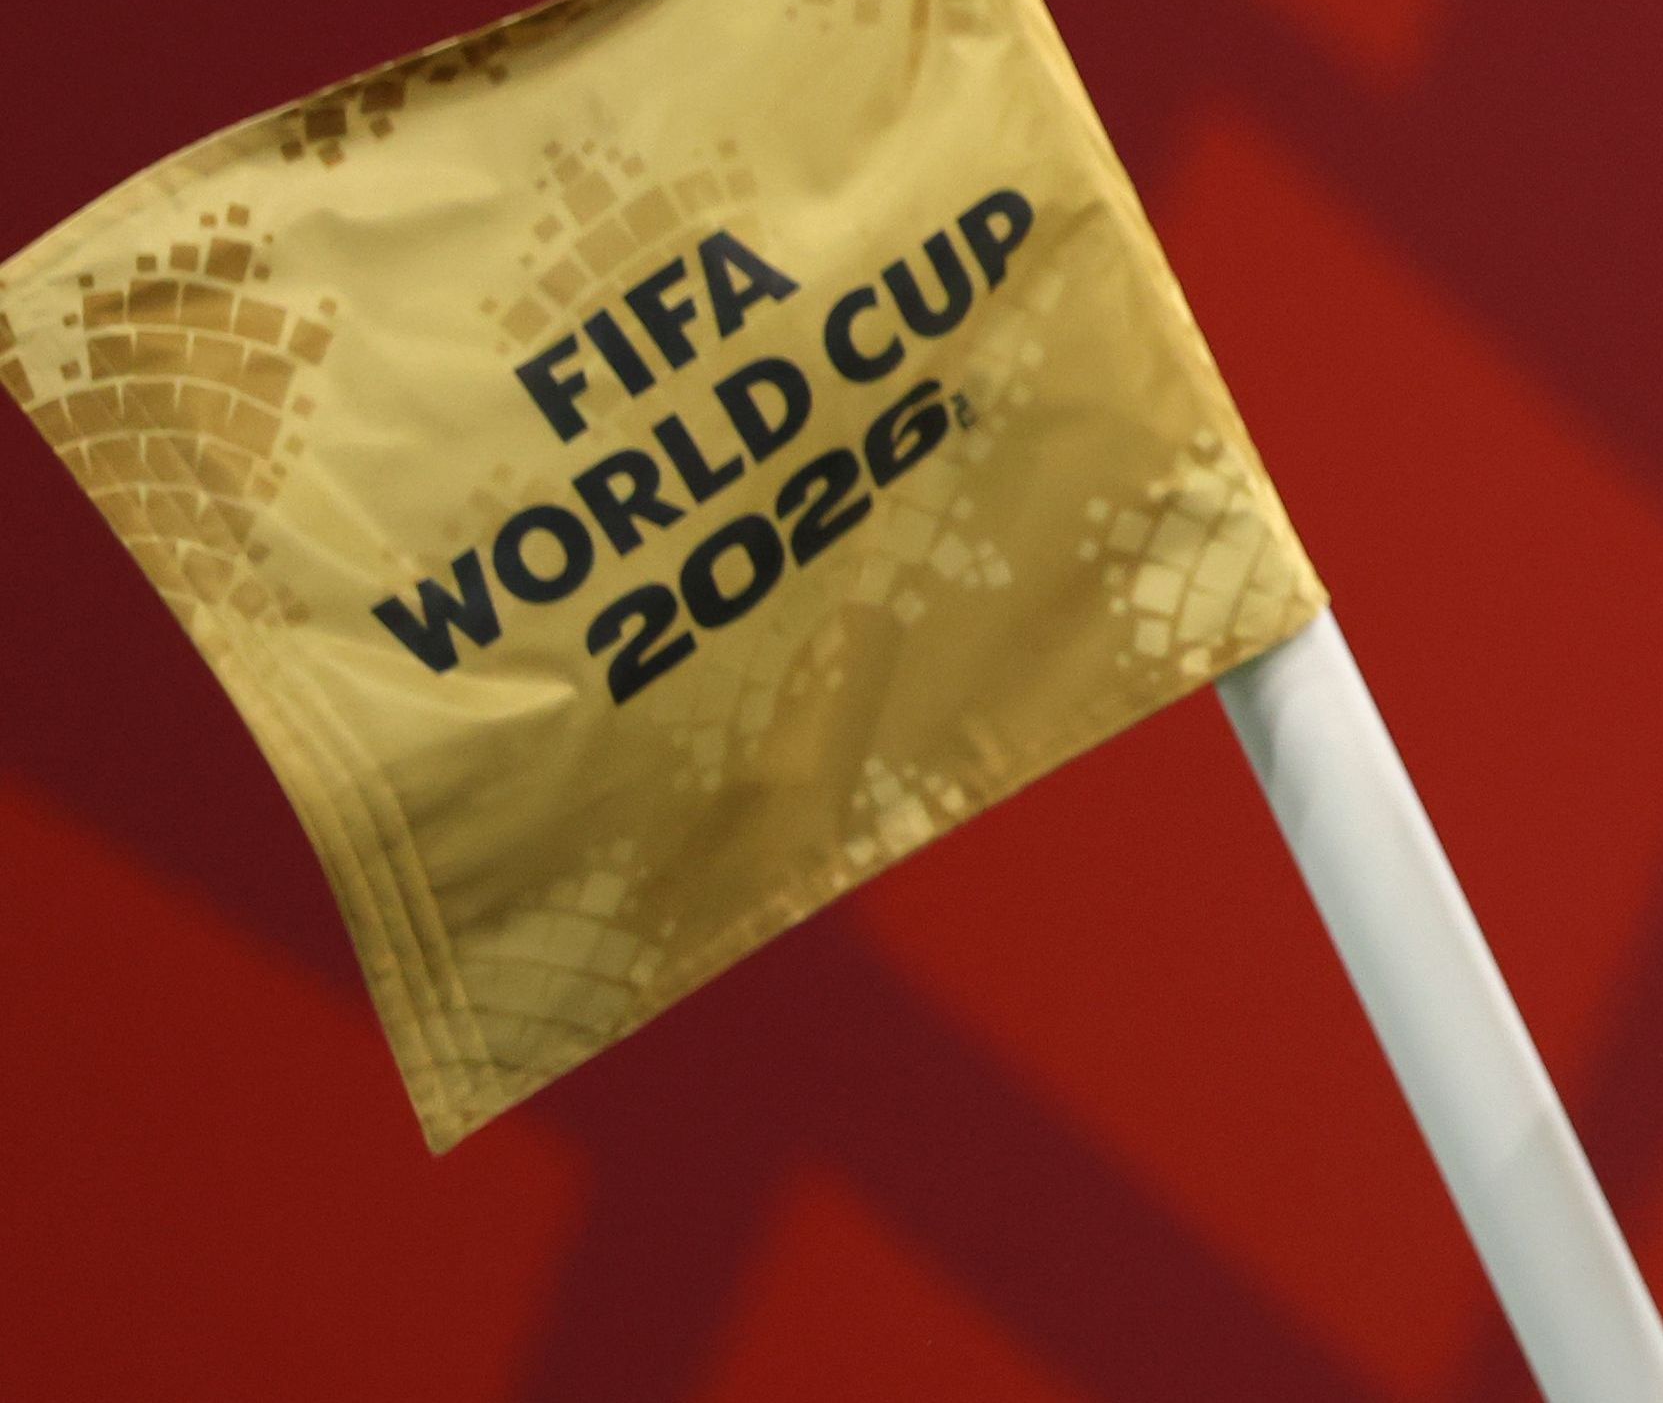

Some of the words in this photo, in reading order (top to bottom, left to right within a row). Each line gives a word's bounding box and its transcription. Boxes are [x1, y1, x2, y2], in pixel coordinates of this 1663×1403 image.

[371, 357, 812, 674] WORLD
[823, 188, 1034, 384] CUP
[514, 229, 801, 444] FIFA
[585, 378, 949, 706] 2026
